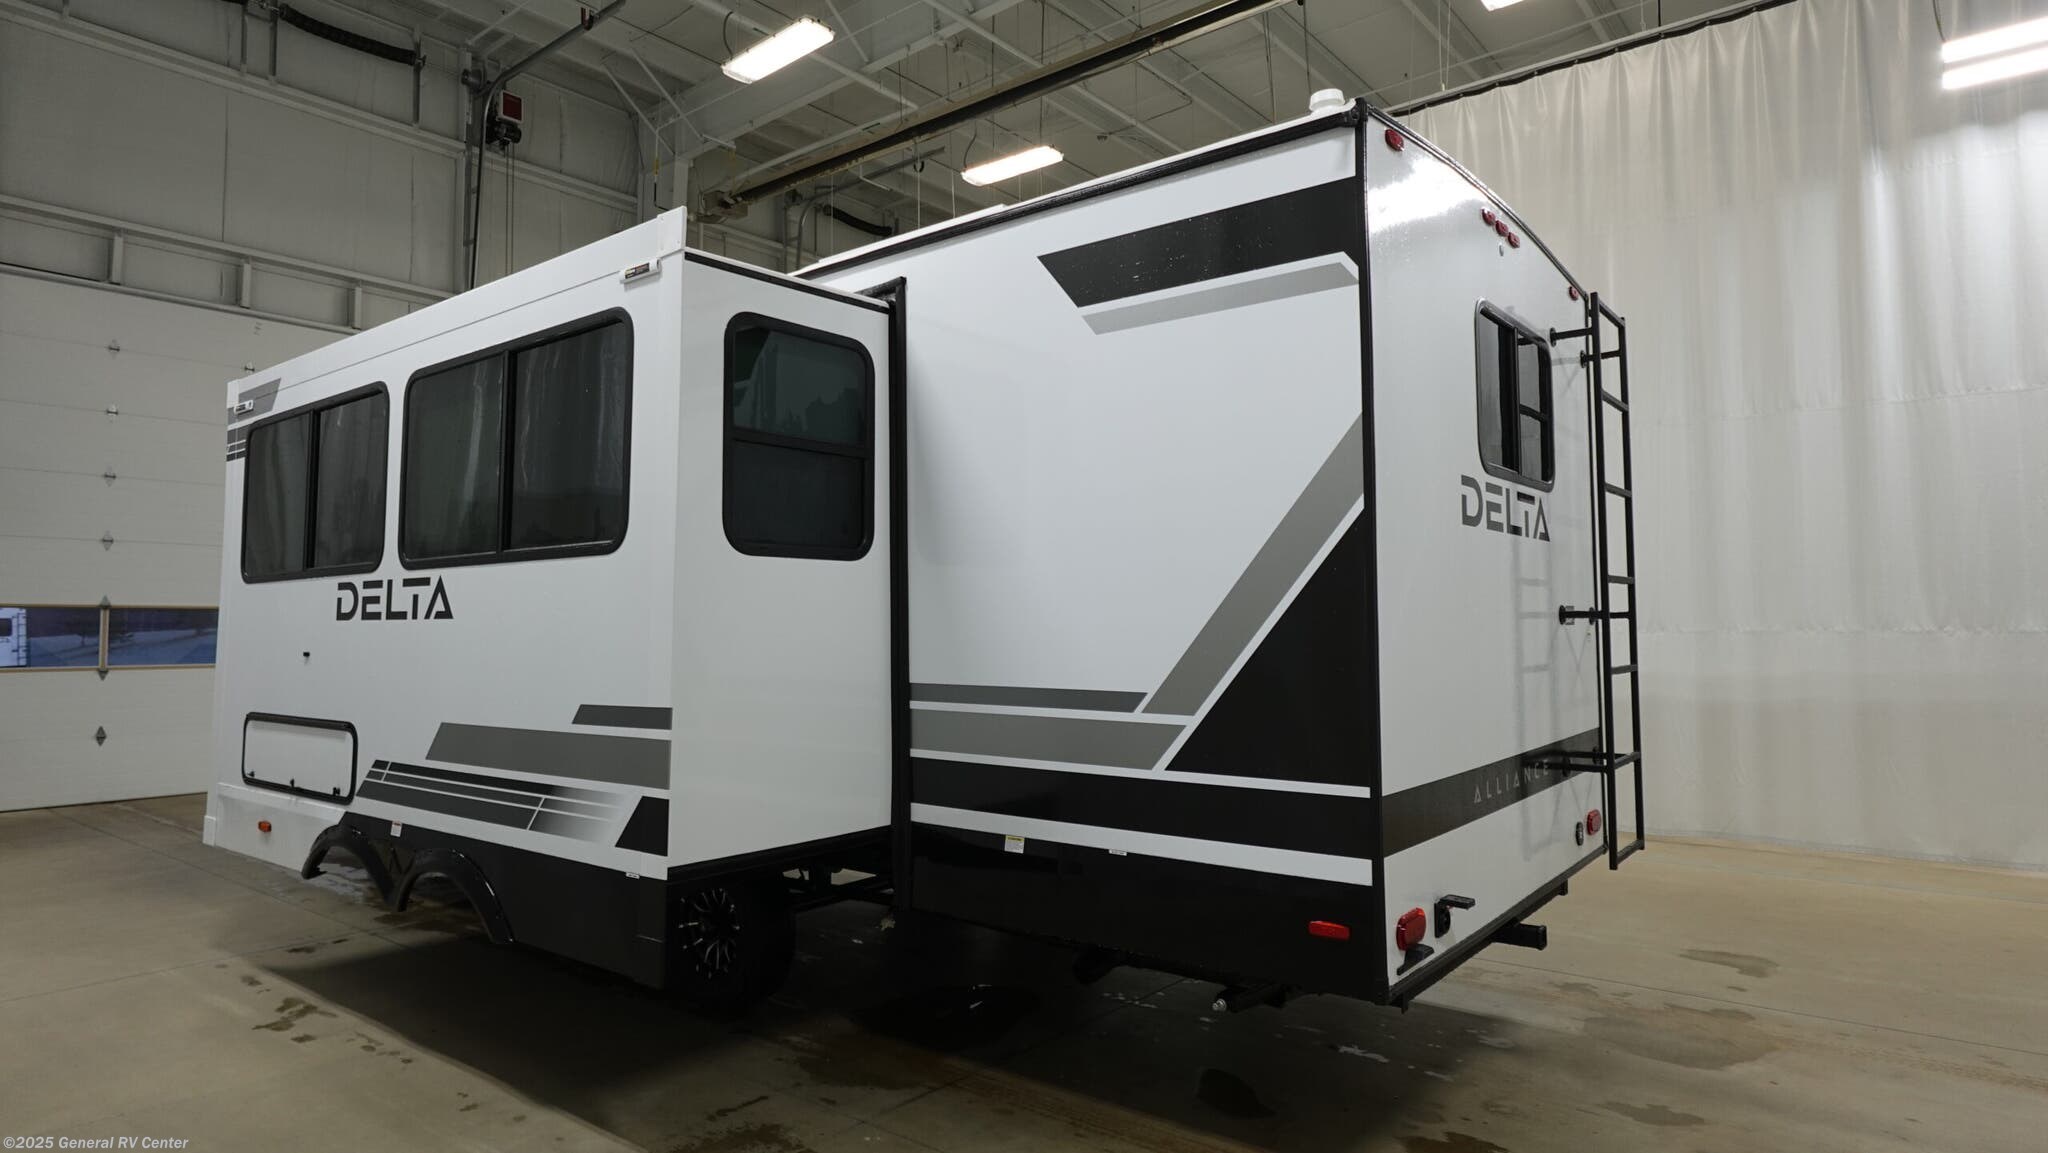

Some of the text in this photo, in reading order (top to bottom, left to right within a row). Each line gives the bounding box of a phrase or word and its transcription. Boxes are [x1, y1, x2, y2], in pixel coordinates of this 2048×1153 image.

[1461, 475, 1550, 542] DELTA
[336, 575, 454, 621] DELTA
[1473, 759, 1549, 804] ALLIANCE
